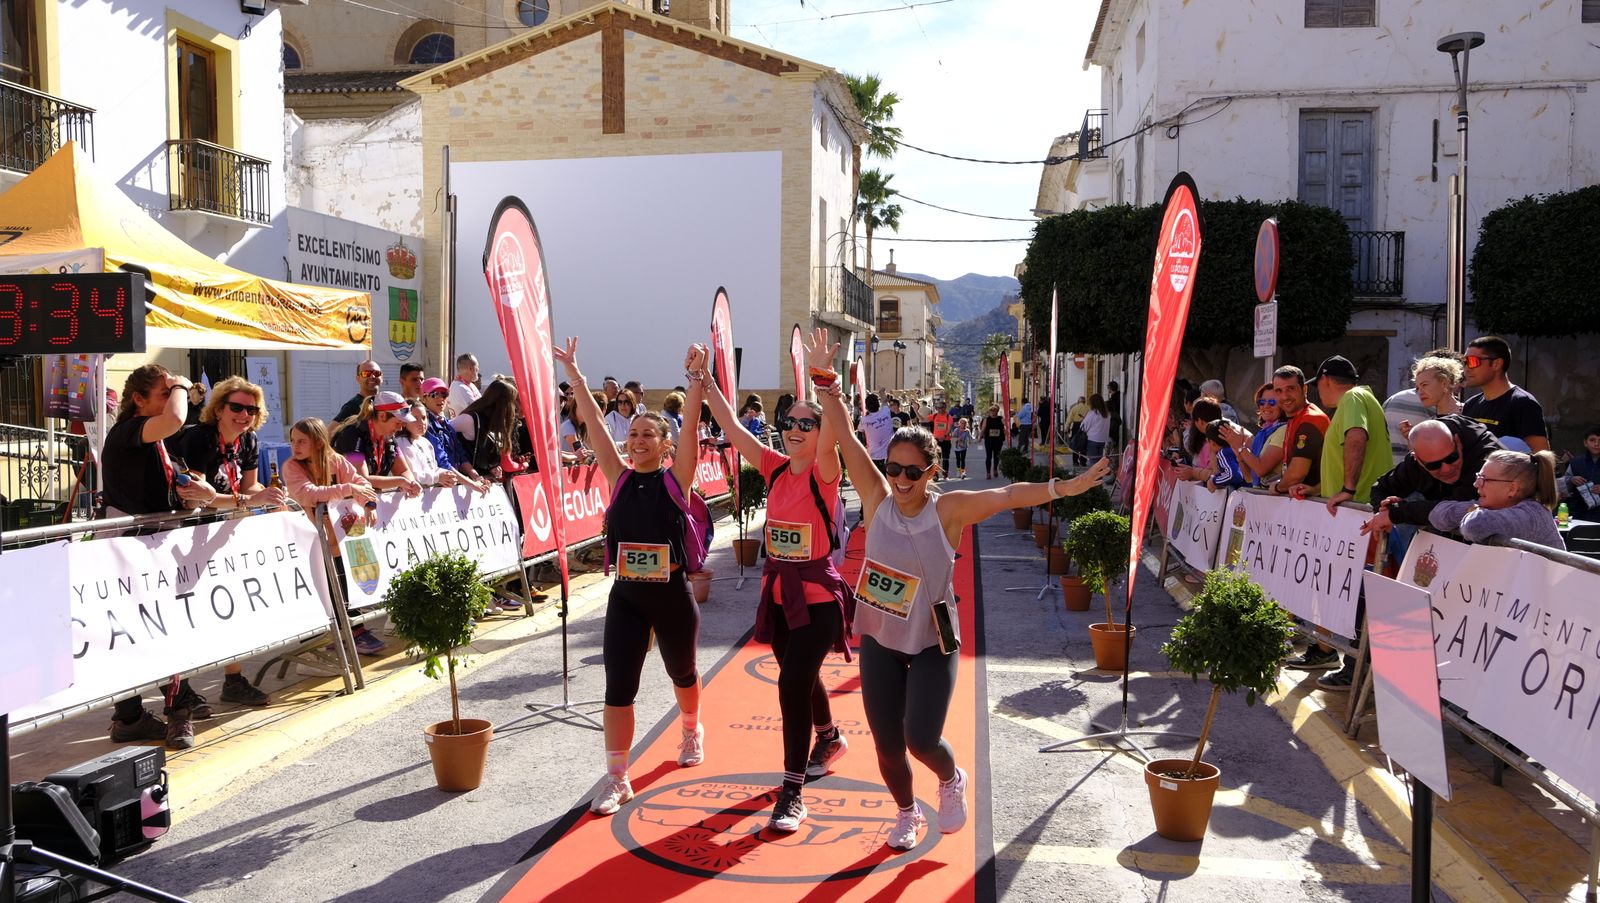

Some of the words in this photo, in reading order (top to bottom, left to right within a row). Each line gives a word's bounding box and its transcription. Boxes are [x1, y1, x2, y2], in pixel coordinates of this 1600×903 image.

[297, 233, 381, 266] EXCELENTÍSIMO
[301, 263, 381, 291] AYUNTAMIENTO
[382, 506, 485, 534] AYUNTAMIENTO
[489, 503, 504, 517] DE
[563, 486, 607, 522] EOLIA
[385, 520, 512, 569] CANTORIA
[771, 529, 801, 544] 550
[1336, 540, 1355, 560] DE
[73, 550, 266, 604] YUNTAMIENTO
[275, 542, 299, 562] DE
[627, 552, 658, 565] 521
[868, 572, 906, 596] 697
[72, 567, 312, 659] CANTORIA
[1442, 580, 1600, 660] YUNTMIENT
[1431, 606, 1600, 731] CANTORI
[701, 782, 764, 792] antoria
